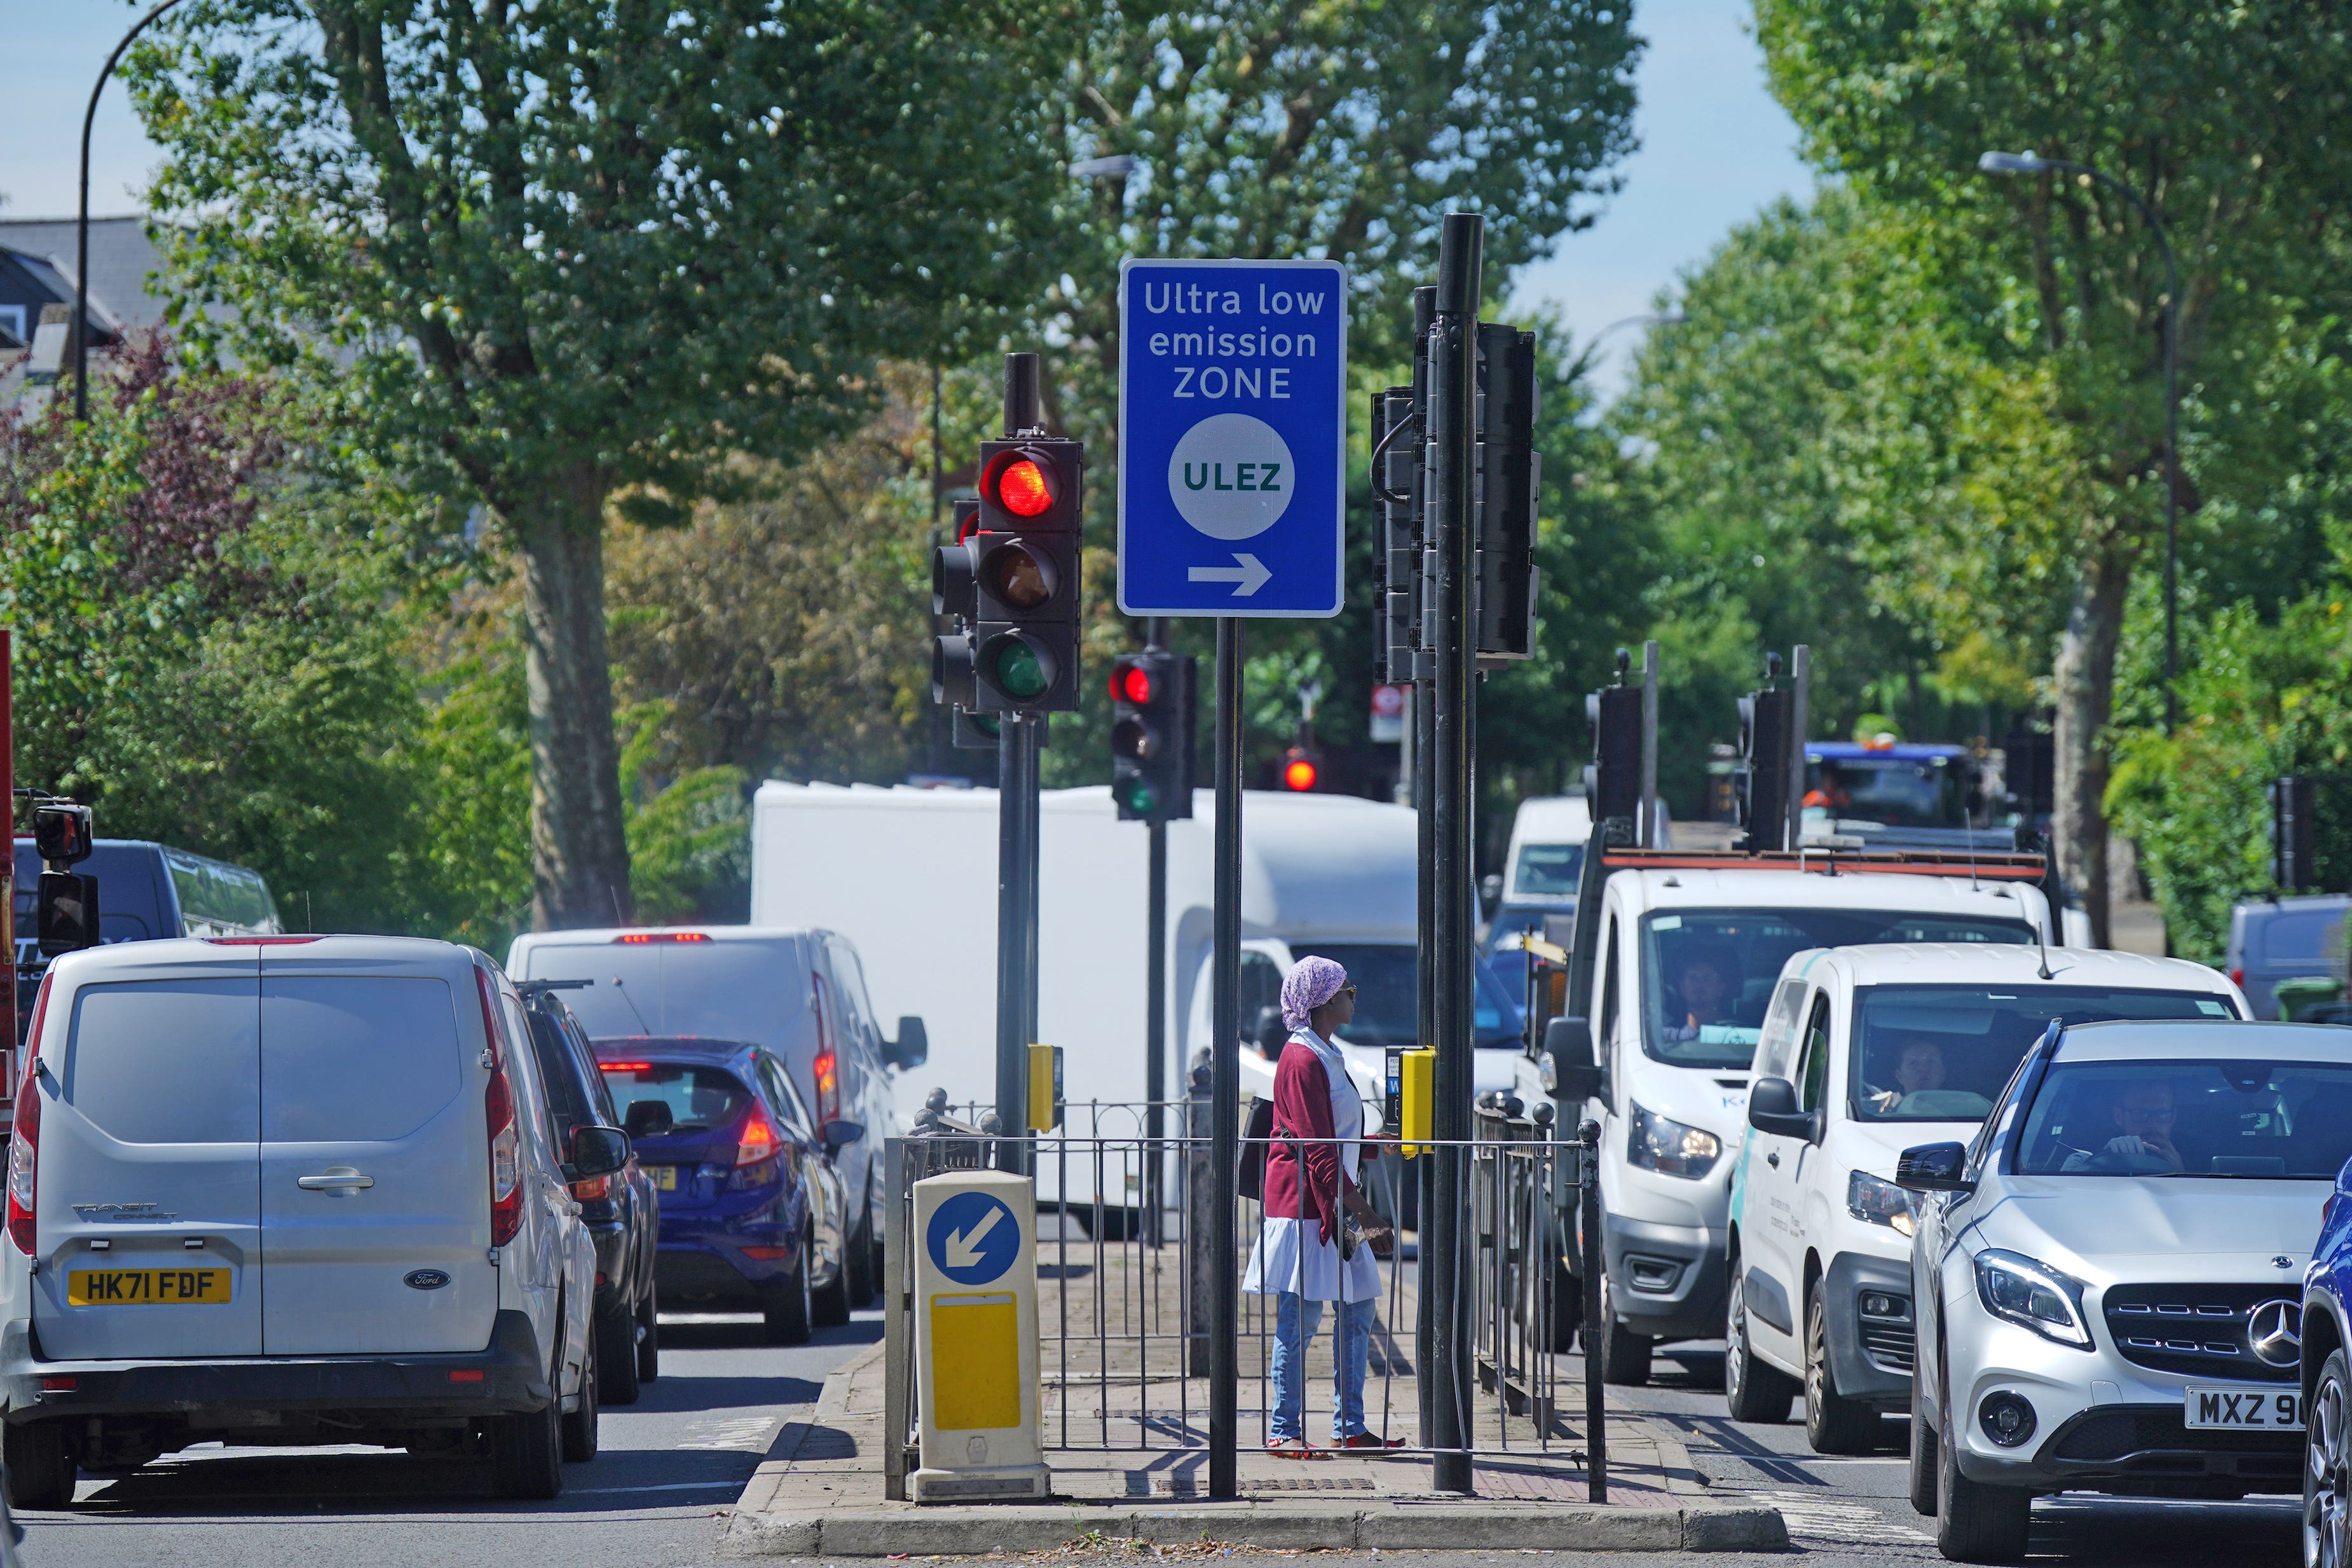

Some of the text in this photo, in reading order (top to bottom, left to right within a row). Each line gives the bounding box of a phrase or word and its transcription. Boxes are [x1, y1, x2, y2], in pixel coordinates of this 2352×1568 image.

[1145, 282, 1325, 315] Ultra low
[1149, 325, 1316, 357] emission
[1173, 366, 1291, 399] ZONE
[1184, 463, 1281, 491] ULEZ
[71, 1203, 158, 1213] TRANSIT
[113, 1212, 178, 1220] CONNECT
[87, 1272, 214, 1300] HK71 FDF
[415, 1273, 439, 1284] Ford
[2200, 1393, 2266, 1424] MXZ
